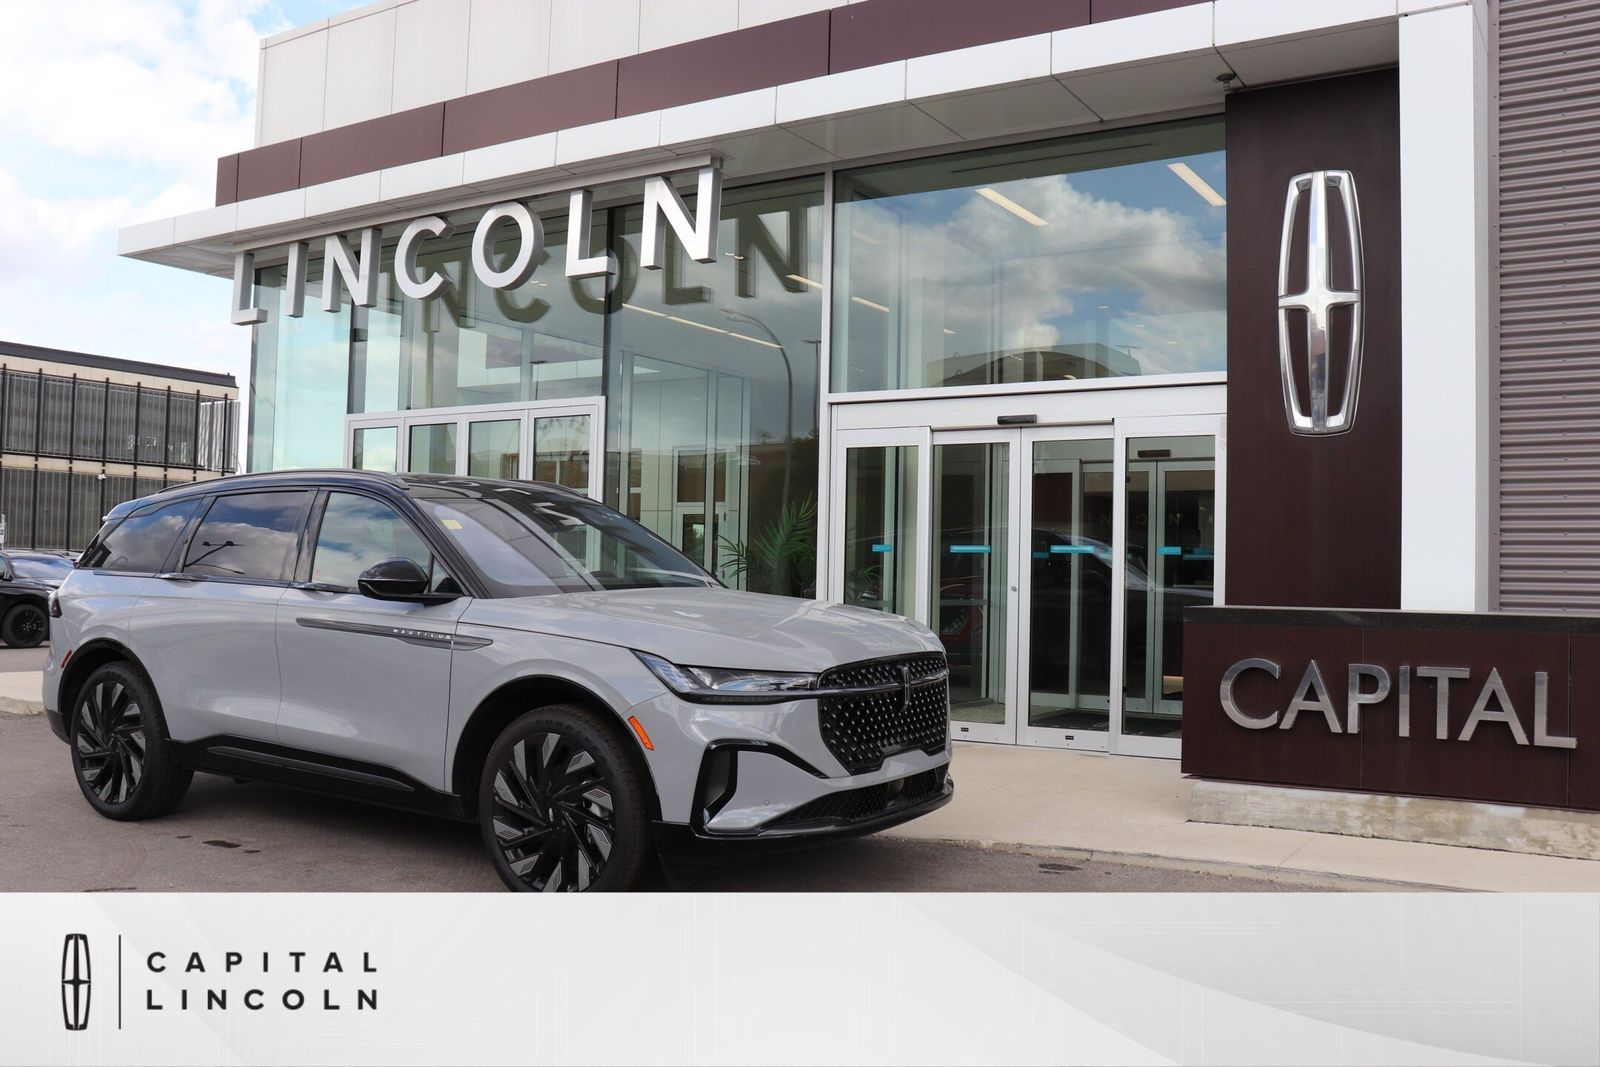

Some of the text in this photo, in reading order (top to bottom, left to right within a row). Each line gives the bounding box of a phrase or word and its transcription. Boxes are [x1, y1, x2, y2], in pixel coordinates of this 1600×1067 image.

[231, 163, 723, 326] LINCOLN
[392, 628, 452, 640] NAUTILUS
[1219, 657, 1578, 750] CAPITAL
